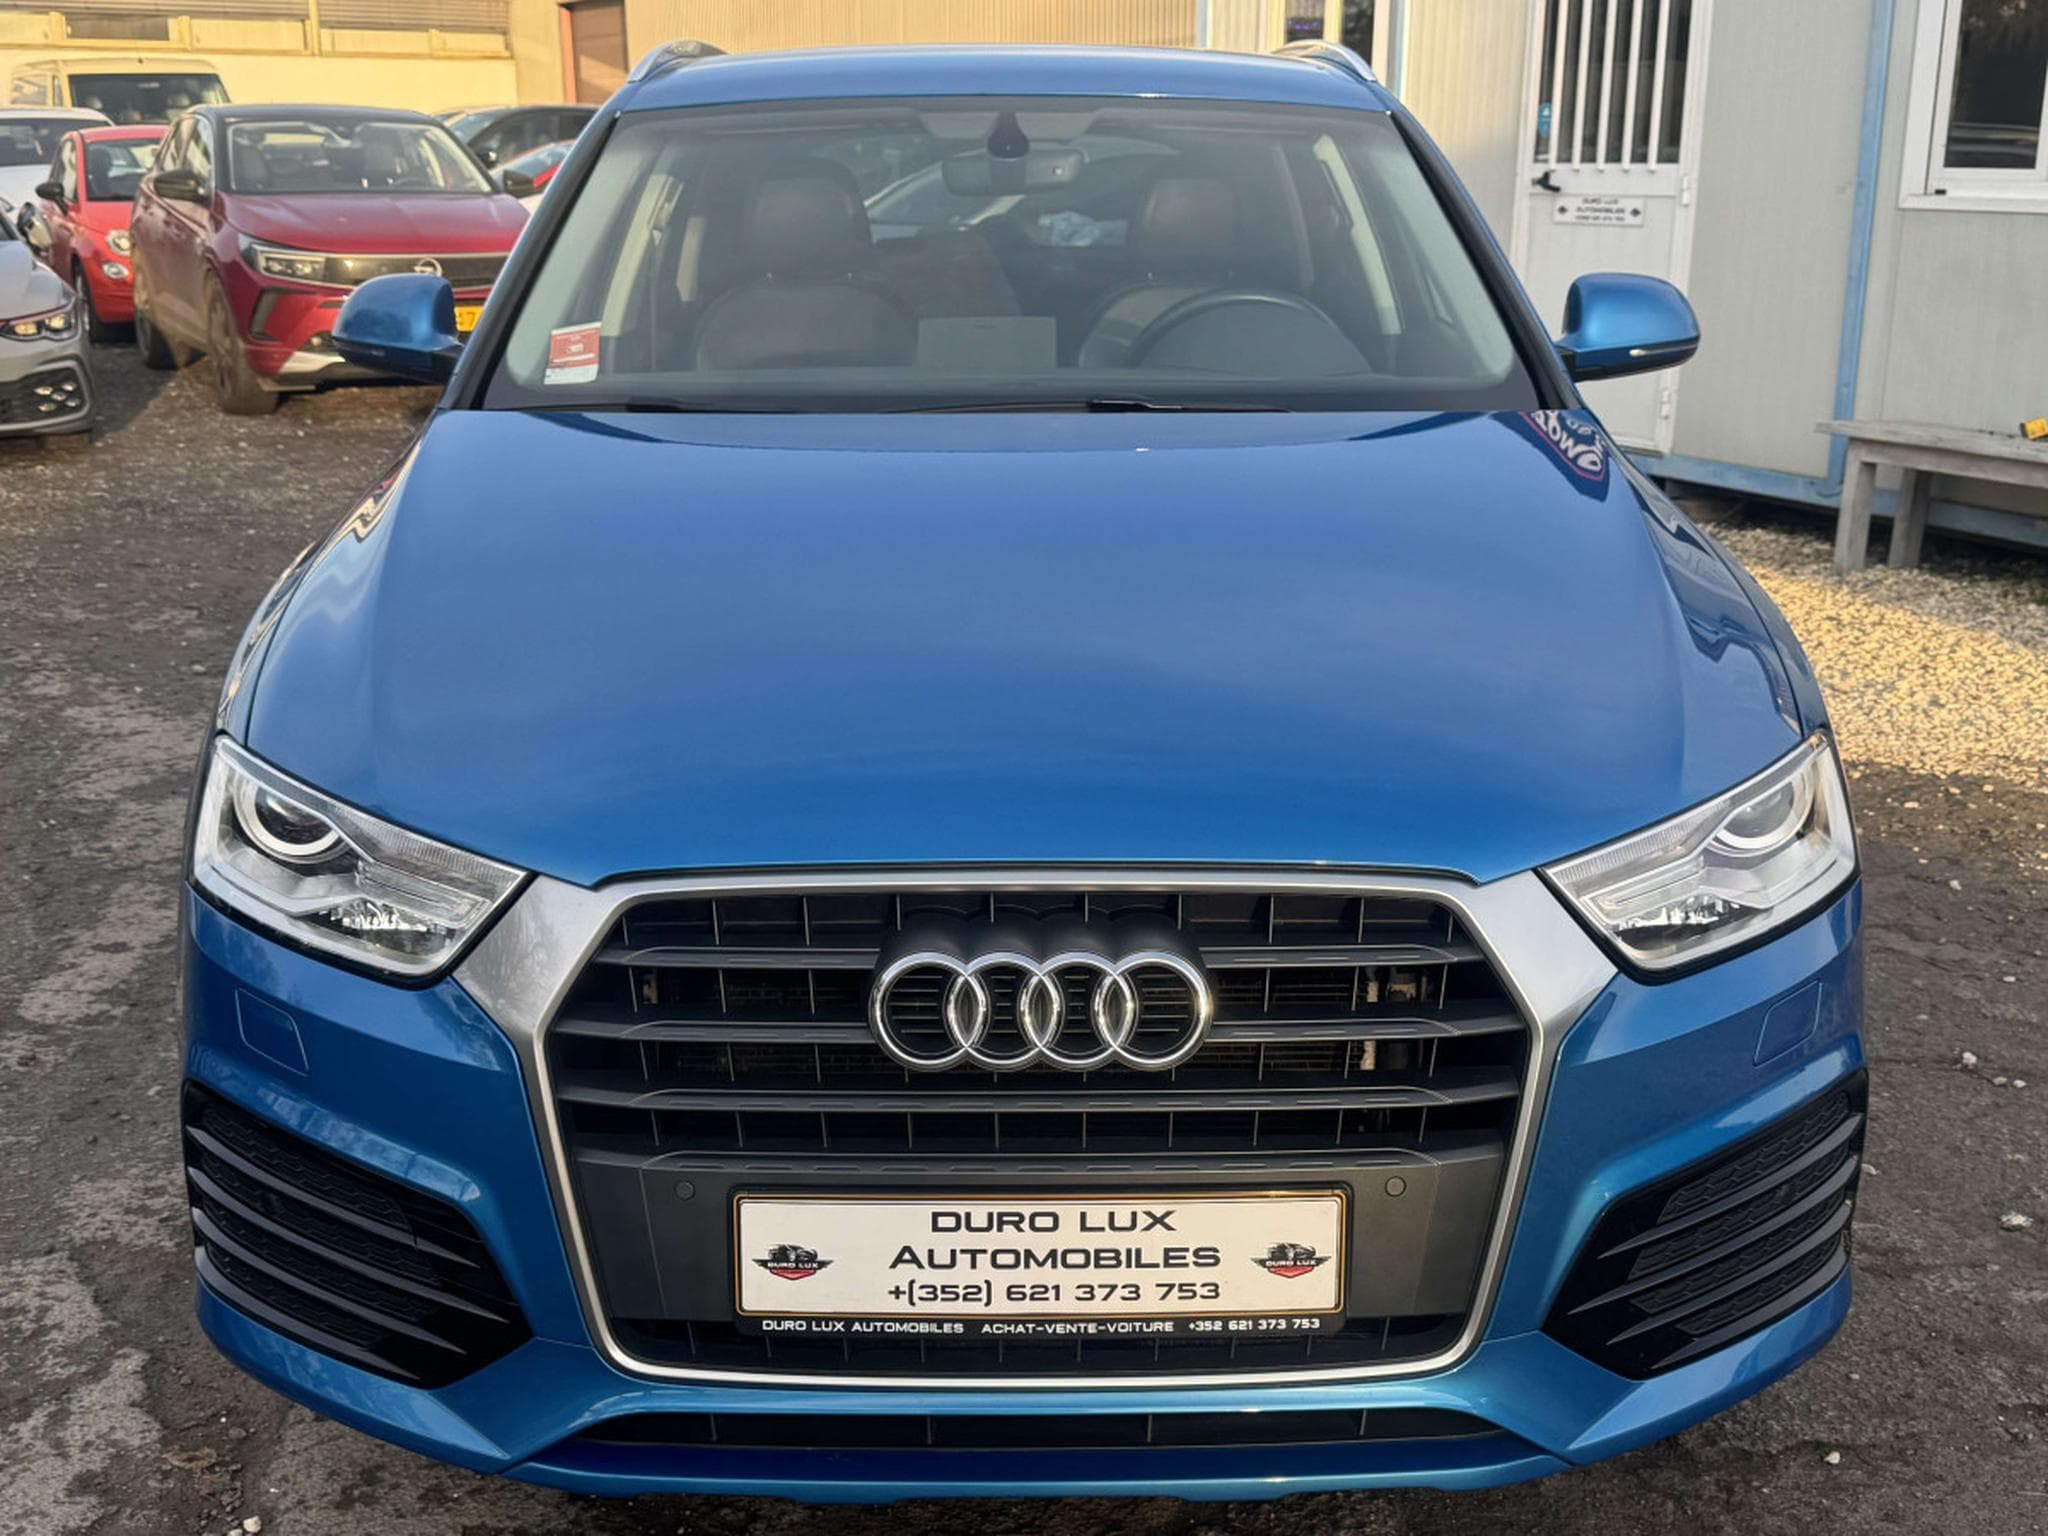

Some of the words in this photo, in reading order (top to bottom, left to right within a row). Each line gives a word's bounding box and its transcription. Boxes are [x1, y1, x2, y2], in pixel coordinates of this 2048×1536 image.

[931, 1211, 1060, 1233] DURO
[1079, 1210, 1177, 1233] LUX
[798, 1261, 819, 1269] LUX
[888, 1245, 1221, 1270] AUTOMOBILES
[888, 1279, 992, 1307] +(352)
[1006, 1284, 1061, 1302] 621
[1075, 1283, 1141, 1302] 373
[1155, 1282, 1220, 1301] 753
[762, 1319, 806, 1331] DURO
[811, 1320, 845, 1332] LUX
[851, 1321, 964, 1334] AUTOMOBILES
[1188, 1319, 1223, 1331] +352
[1228, 1319, 1254, 1331] 621
[1258, 1318, 1288, 1331] 373
[1292, 1317, 1321, 1330] 753
